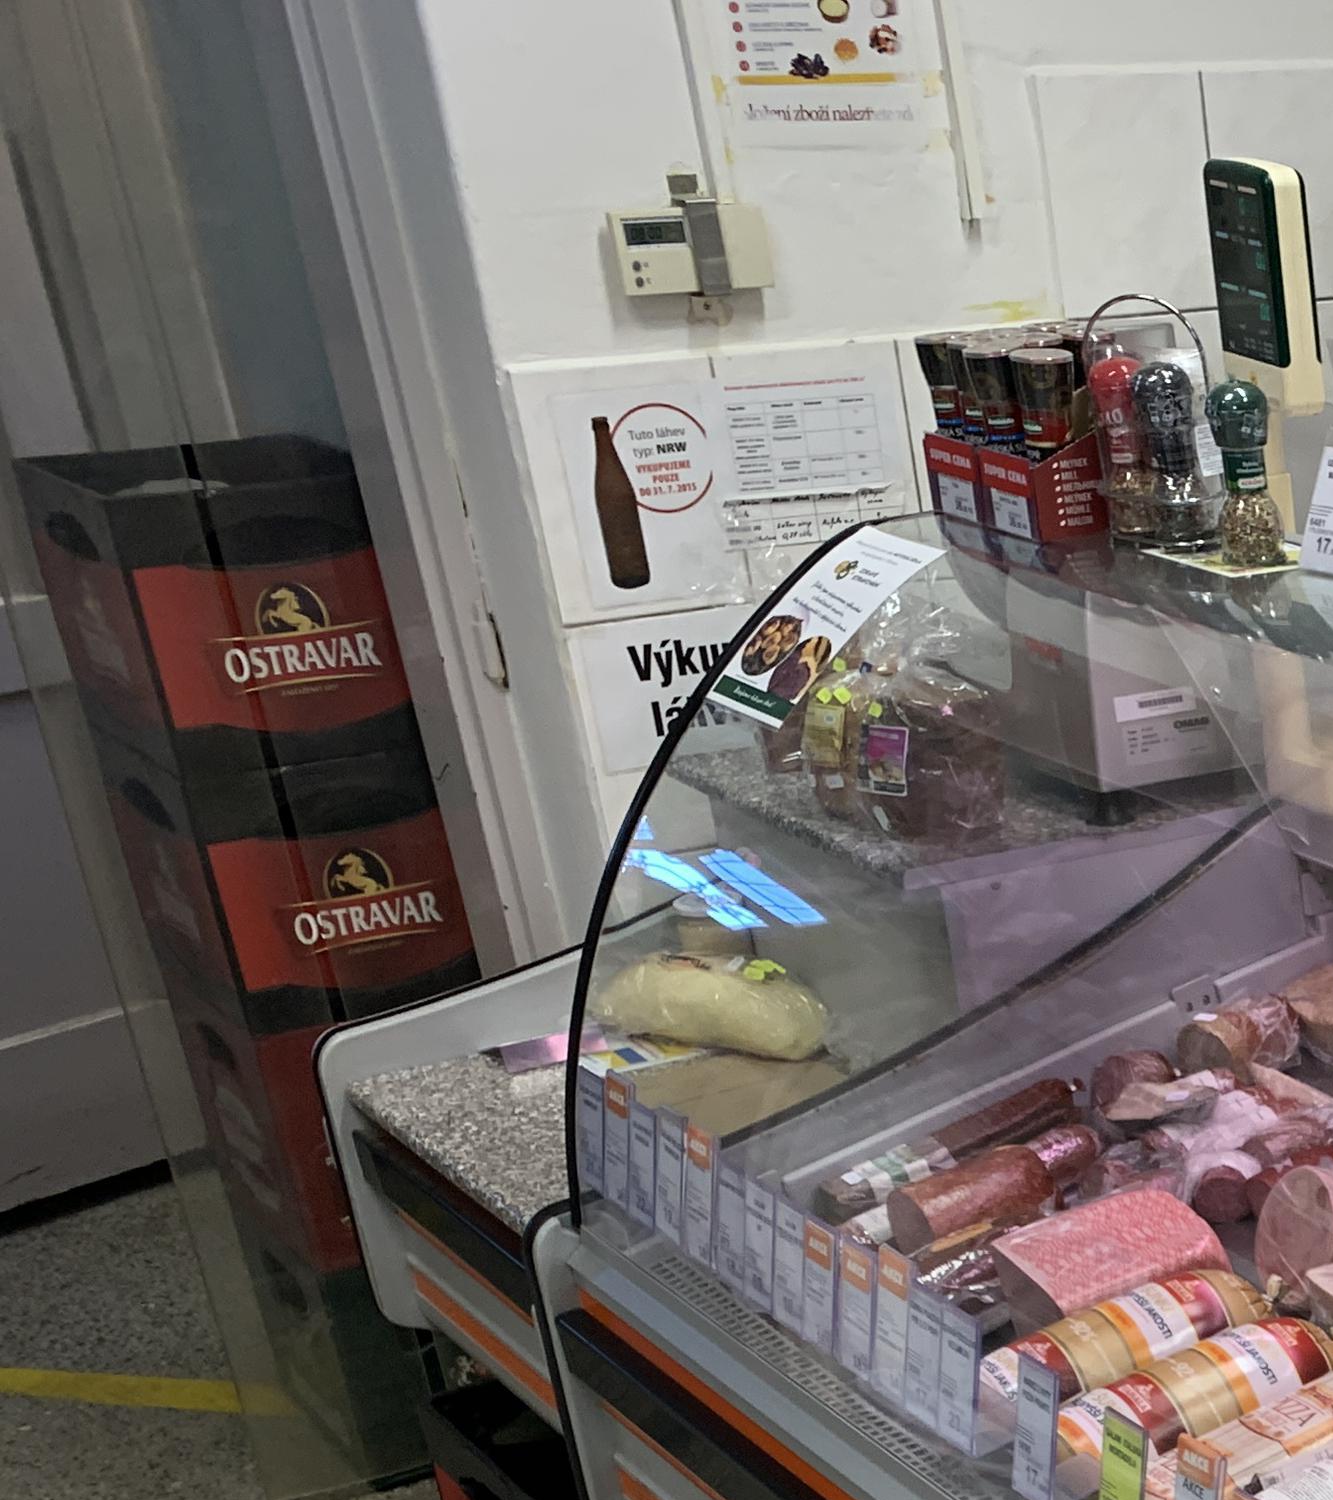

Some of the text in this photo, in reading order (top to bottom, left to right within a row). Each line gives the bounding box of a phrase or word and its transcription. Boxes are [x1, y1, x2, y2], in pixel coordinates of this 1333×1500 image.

[794, 104, 830, 122] zboží
[628, 426, 685, 441] Tuto láhev
[633, 441, 687, 458] typ: NRW
[652, 473, 680, 484] POUZE
[1316, 536, 1331, 554] 17
[224, 631, 383, 684] OSTRAVAR
[293, 890, 444, 946] OSTRAVAR
